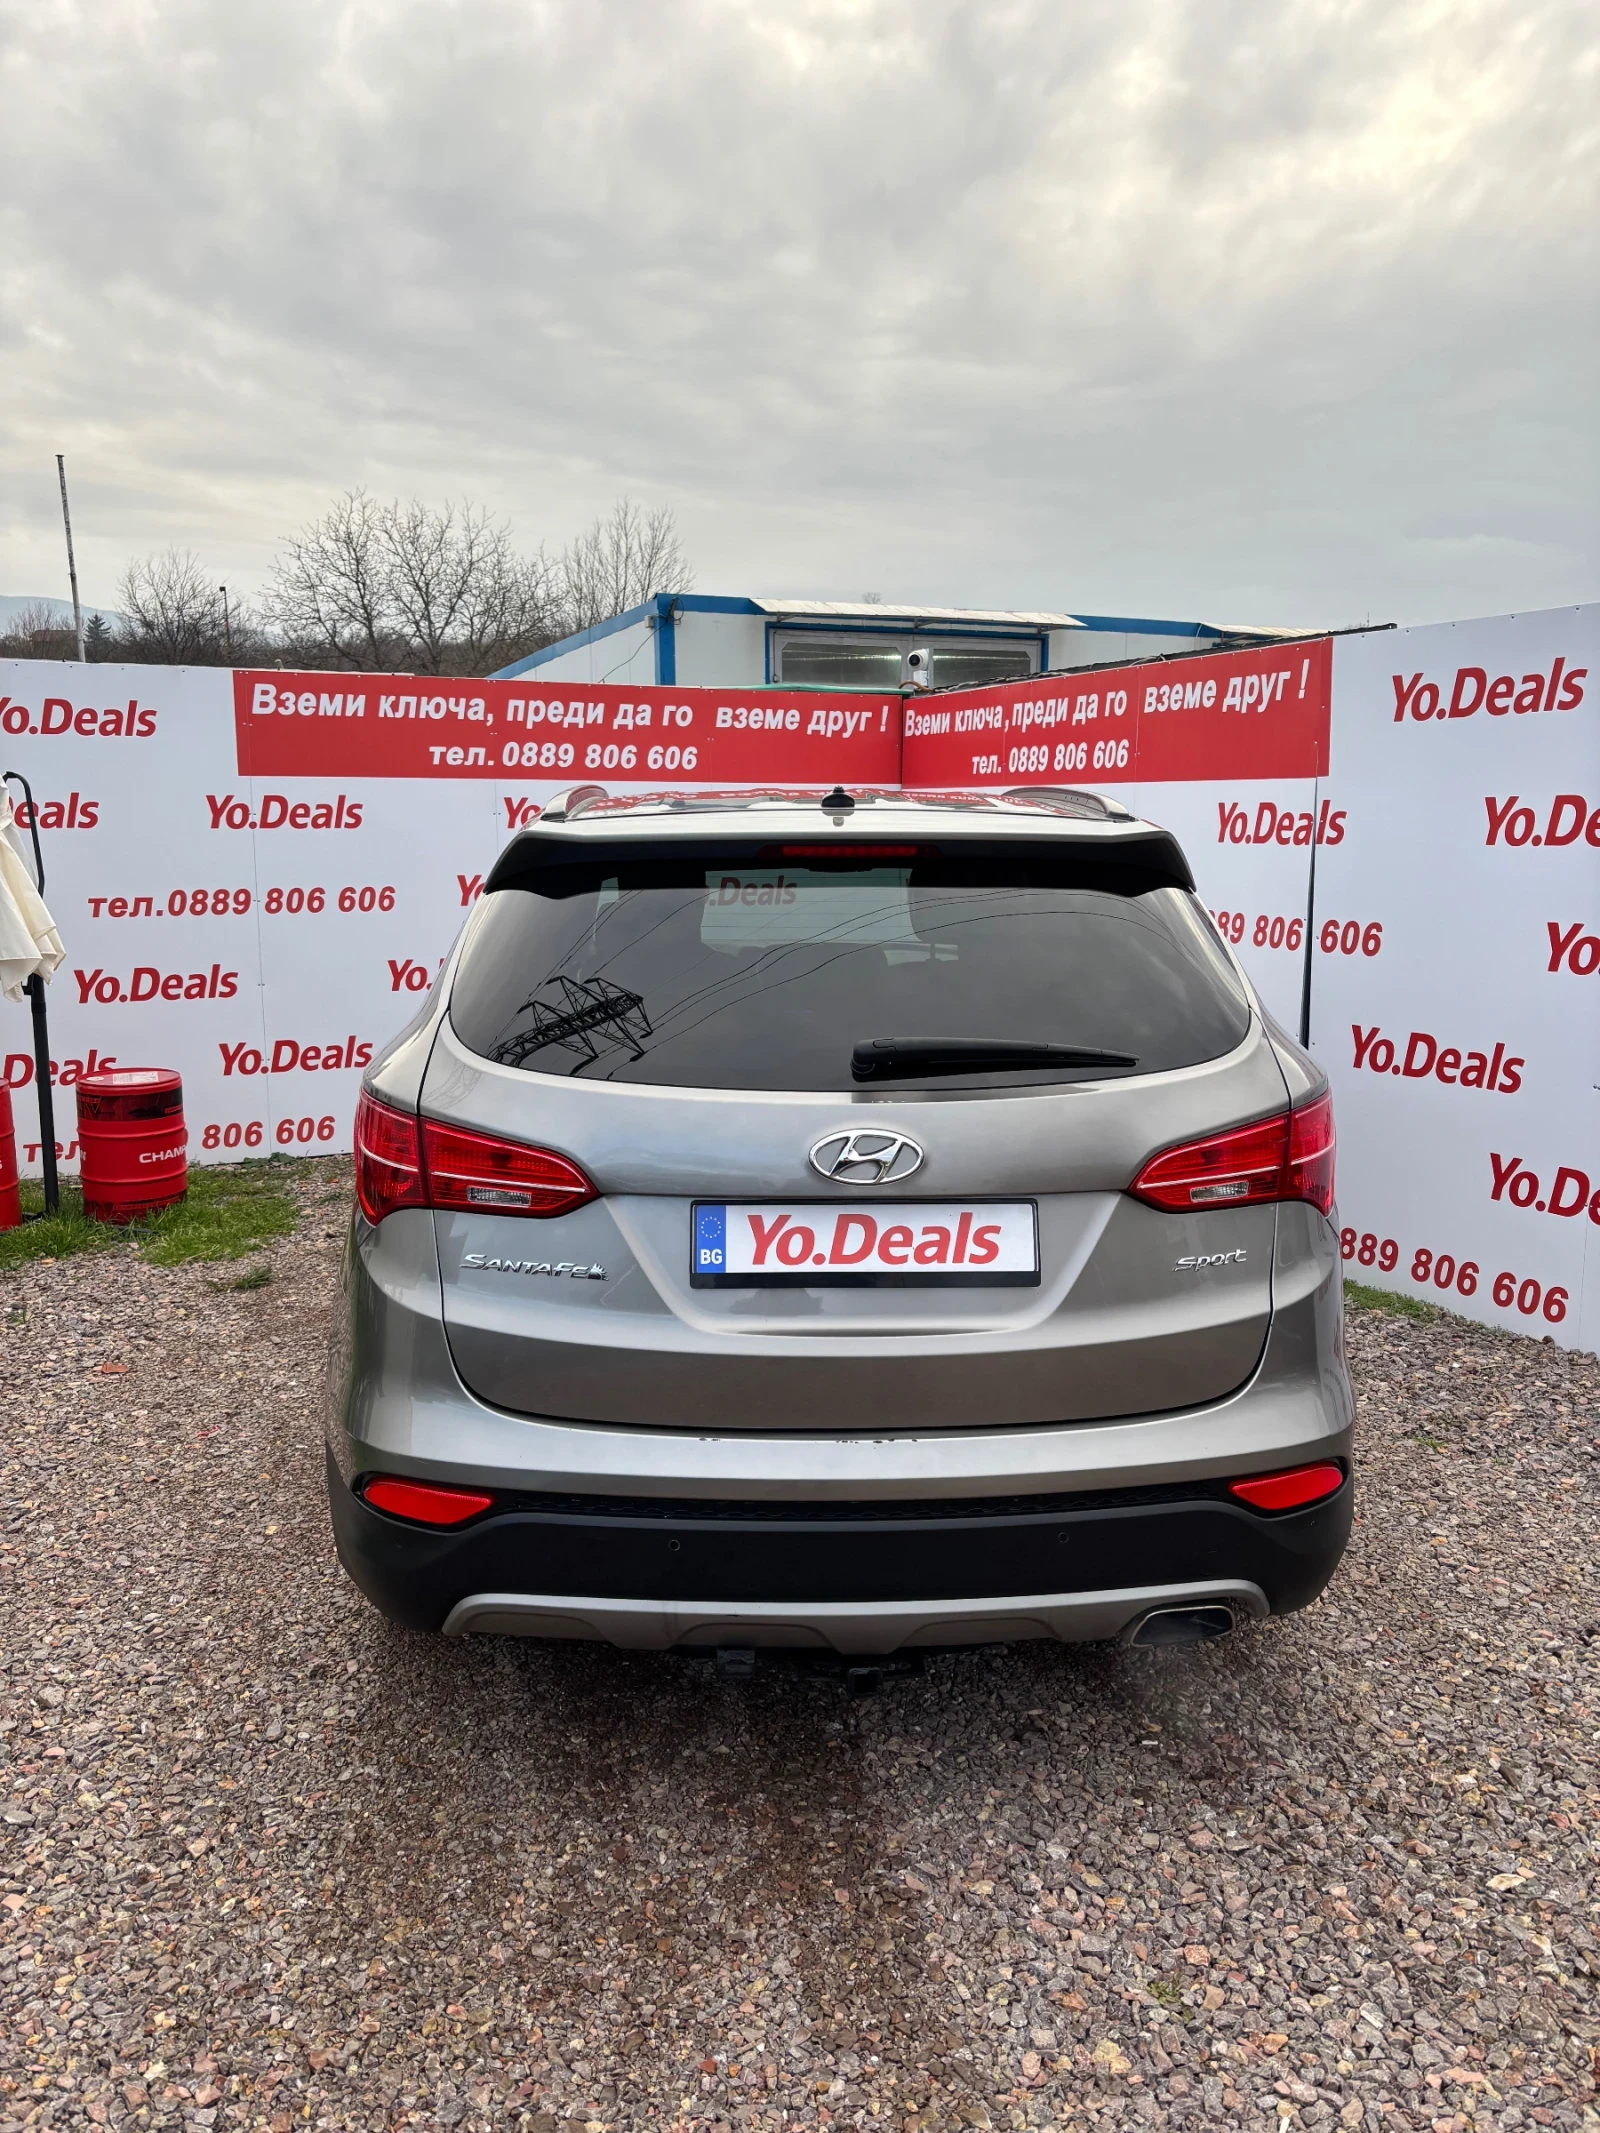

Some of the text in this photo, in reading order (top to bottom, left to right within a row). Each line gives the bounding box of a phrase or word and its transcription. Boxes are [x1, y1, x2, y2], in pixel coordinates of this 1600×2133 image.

[906, 710, 950, 737] Вземи
[1012, 698, 1068, 732] преди
[1072, 693, 1098, 725] да
[1105, 690, 1127, 717] го
[1144, 680, 1216, 713] вземе
[1223, 670, 1291, 713] друг
[1393, 658, 1586, 721] Yo.Deals
[253, 683, 365, 716] Вземи
[379, 694, 494, 726] ключа,
[507, 699, 604, 729] преди
[613, 703, 651, 730] да
[662, 705, 692, 726] го
[716, 708, 800, 730] вземе
[807, 710, 872, 738] друг
[429, 742, 697, 770] тел. 0889 806 606
[972, 739, 1129, 775] тел. 0889 806 606
[206, 795, 363, 830] Yo.Deals
[1218, 800, 1347, 845] Yo.Deals
[88, 886, 395, 917] тел.0889 806 606
[1253, 915, 1303, 951] 806
[1320, 920, 1382, 957] 606
[74, 964, 238, 1004] Yo.Deals
[219, 1036, 373, 1076] Yo.Deals
[1352, 1025, 1525, 1094] Yo.Deals
[202, 1116, 335, 1149] 806 606
[700, 1249, 722, 1264] BG
[748, 1212, 1001, 1266] Yo.Deals
[1411, 1249, 1479, 1296] 806
[1492, 1272, 1568, 1323] 606
